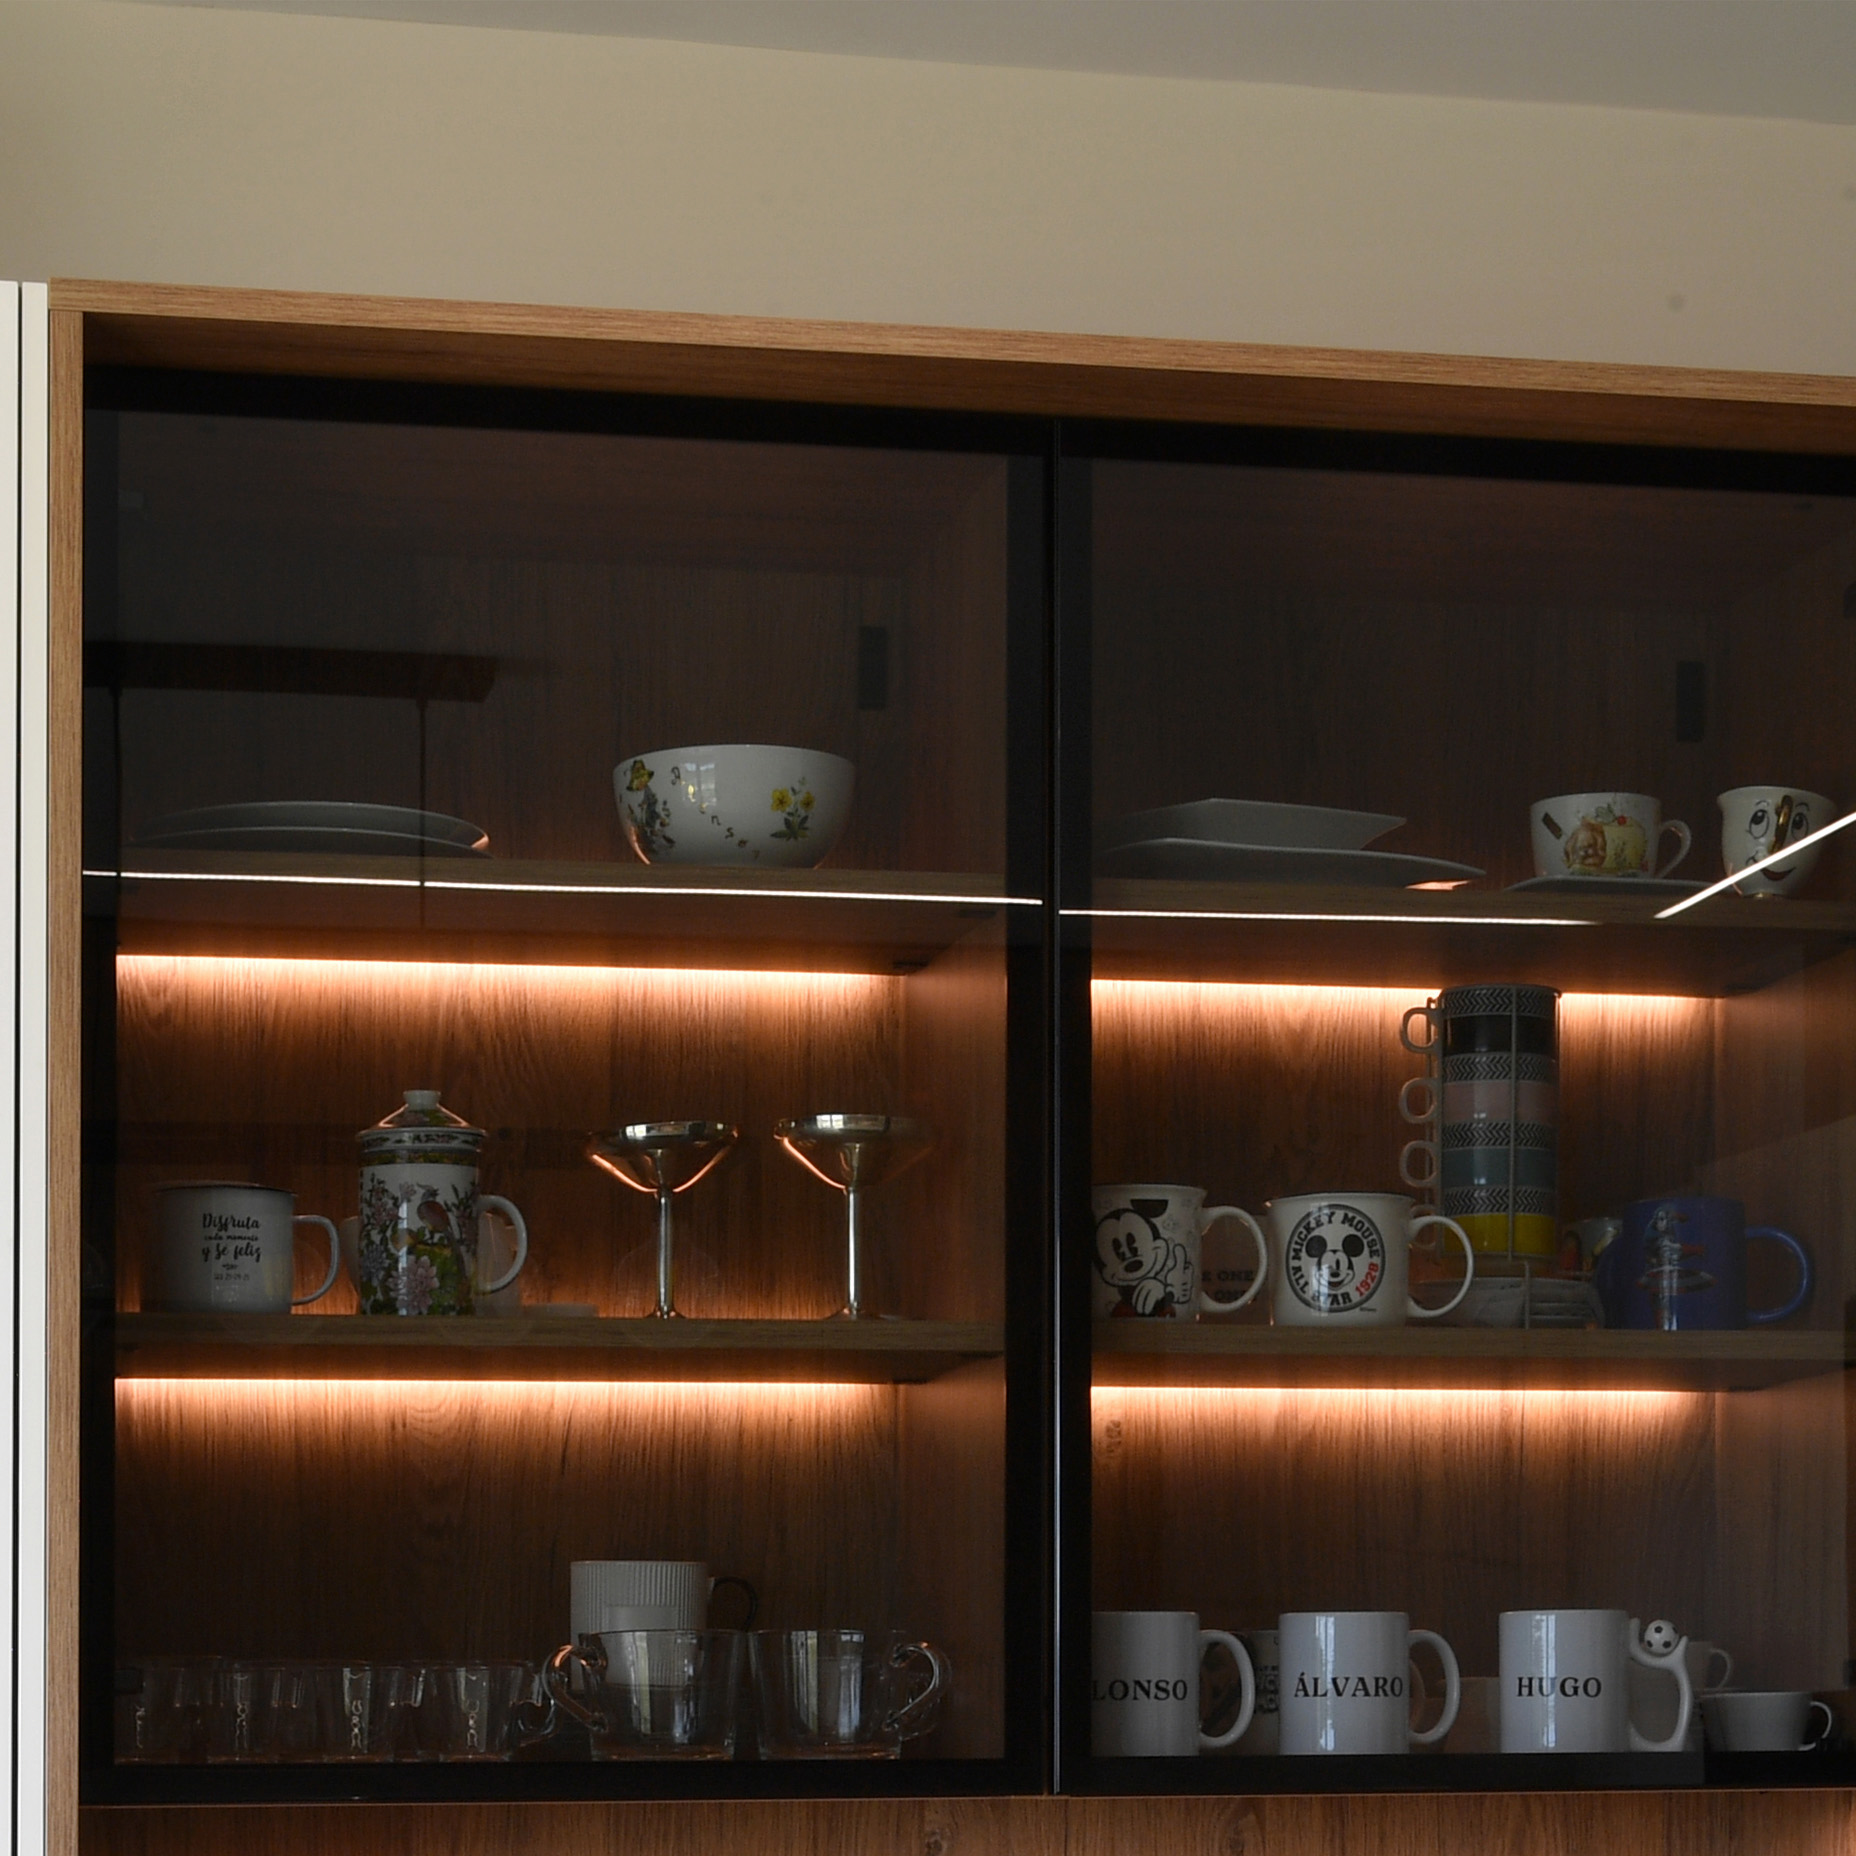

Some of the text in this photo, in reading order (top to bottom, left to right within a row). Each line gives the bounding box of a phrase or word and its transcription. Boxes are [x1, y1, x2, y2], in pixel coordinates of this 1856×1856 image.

[202, 1213, 260, 1232] Disfruta
[1292, 1211, 1380, 1261] MICKEY MOUSE
[233, 1242, 261, 1263] feliz
[1291, 1265, 1310, 1294] ALL
[1355, 1261, 1379, 1297] 1928
[1092, 1679, 1188, 1701] LONSO
[1294, 1672, 1403, 1698] ÁLVARO
[1516, 1676, 1602, 1698] HUGO
